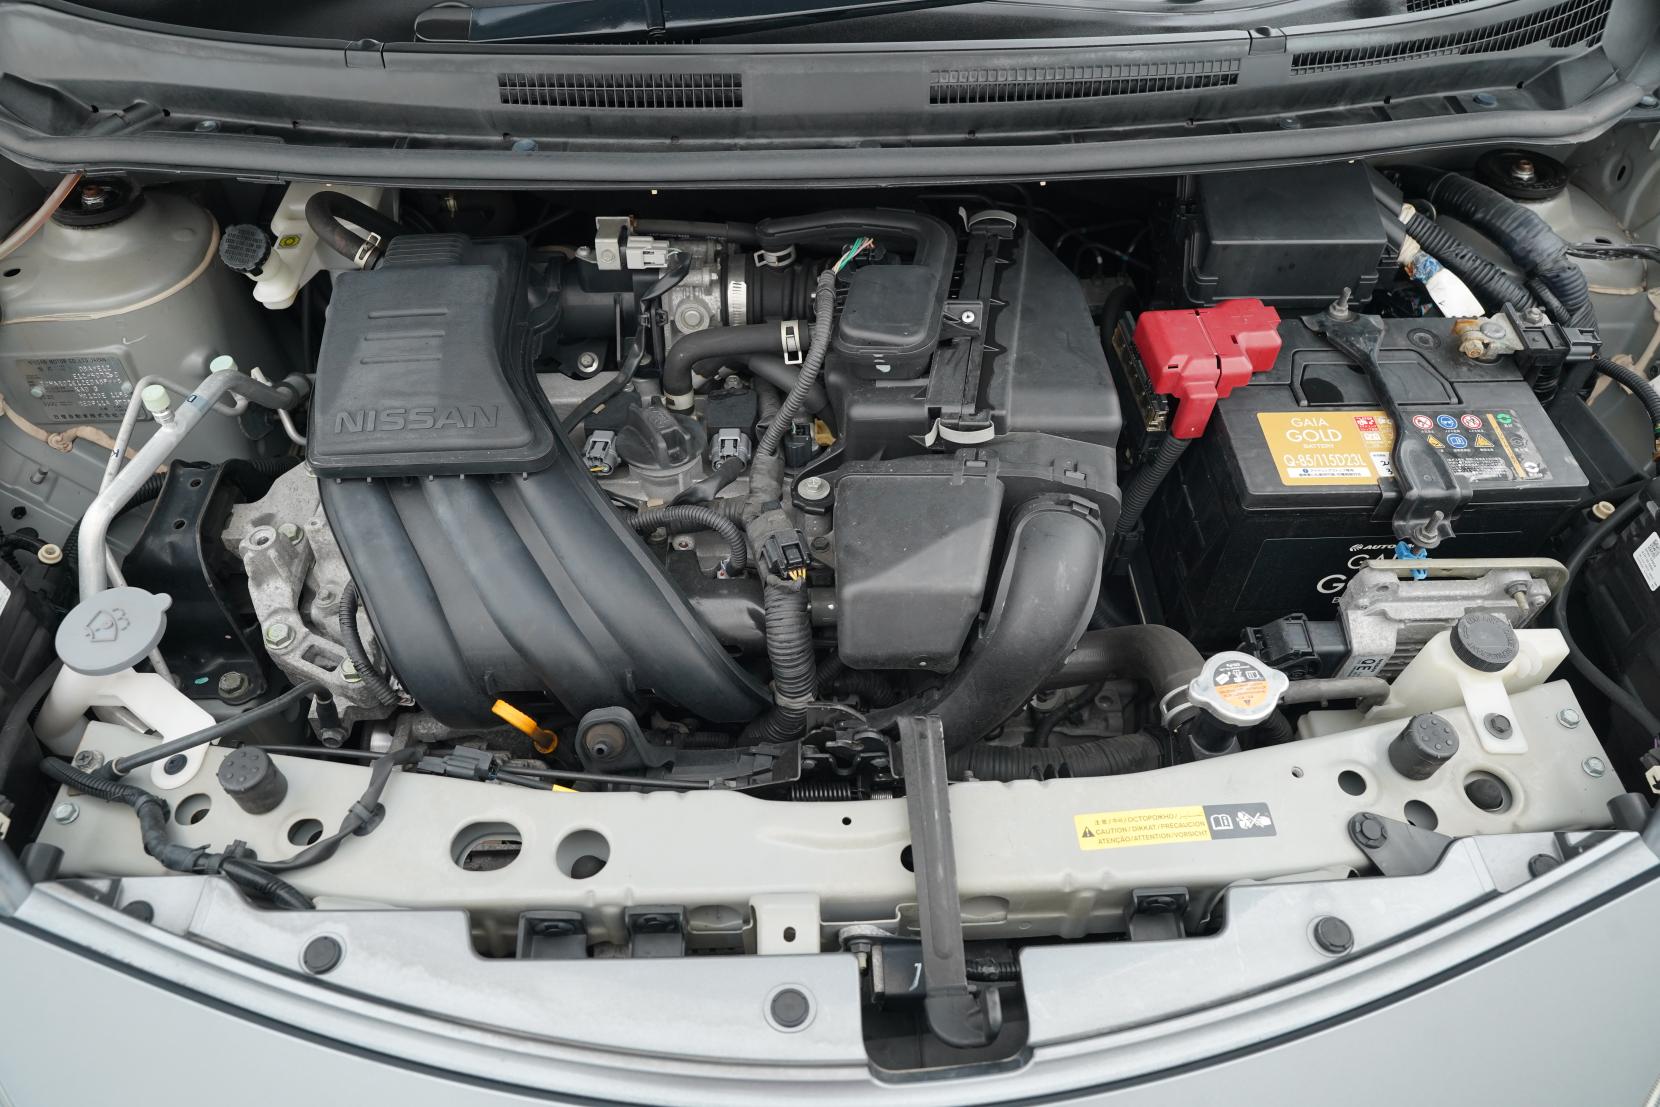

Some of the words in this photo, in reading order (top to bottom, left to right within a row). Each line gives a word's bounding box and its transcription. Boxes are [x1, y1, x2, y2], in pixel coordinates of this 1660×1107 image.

[335, 405, 499, 433] NISSAN
[1290, 417, 1329, 427] GAIA
[1285, 429, 1342, 442] GOLD
[1283, 454, 1368, 467] Q-85/115D23L
